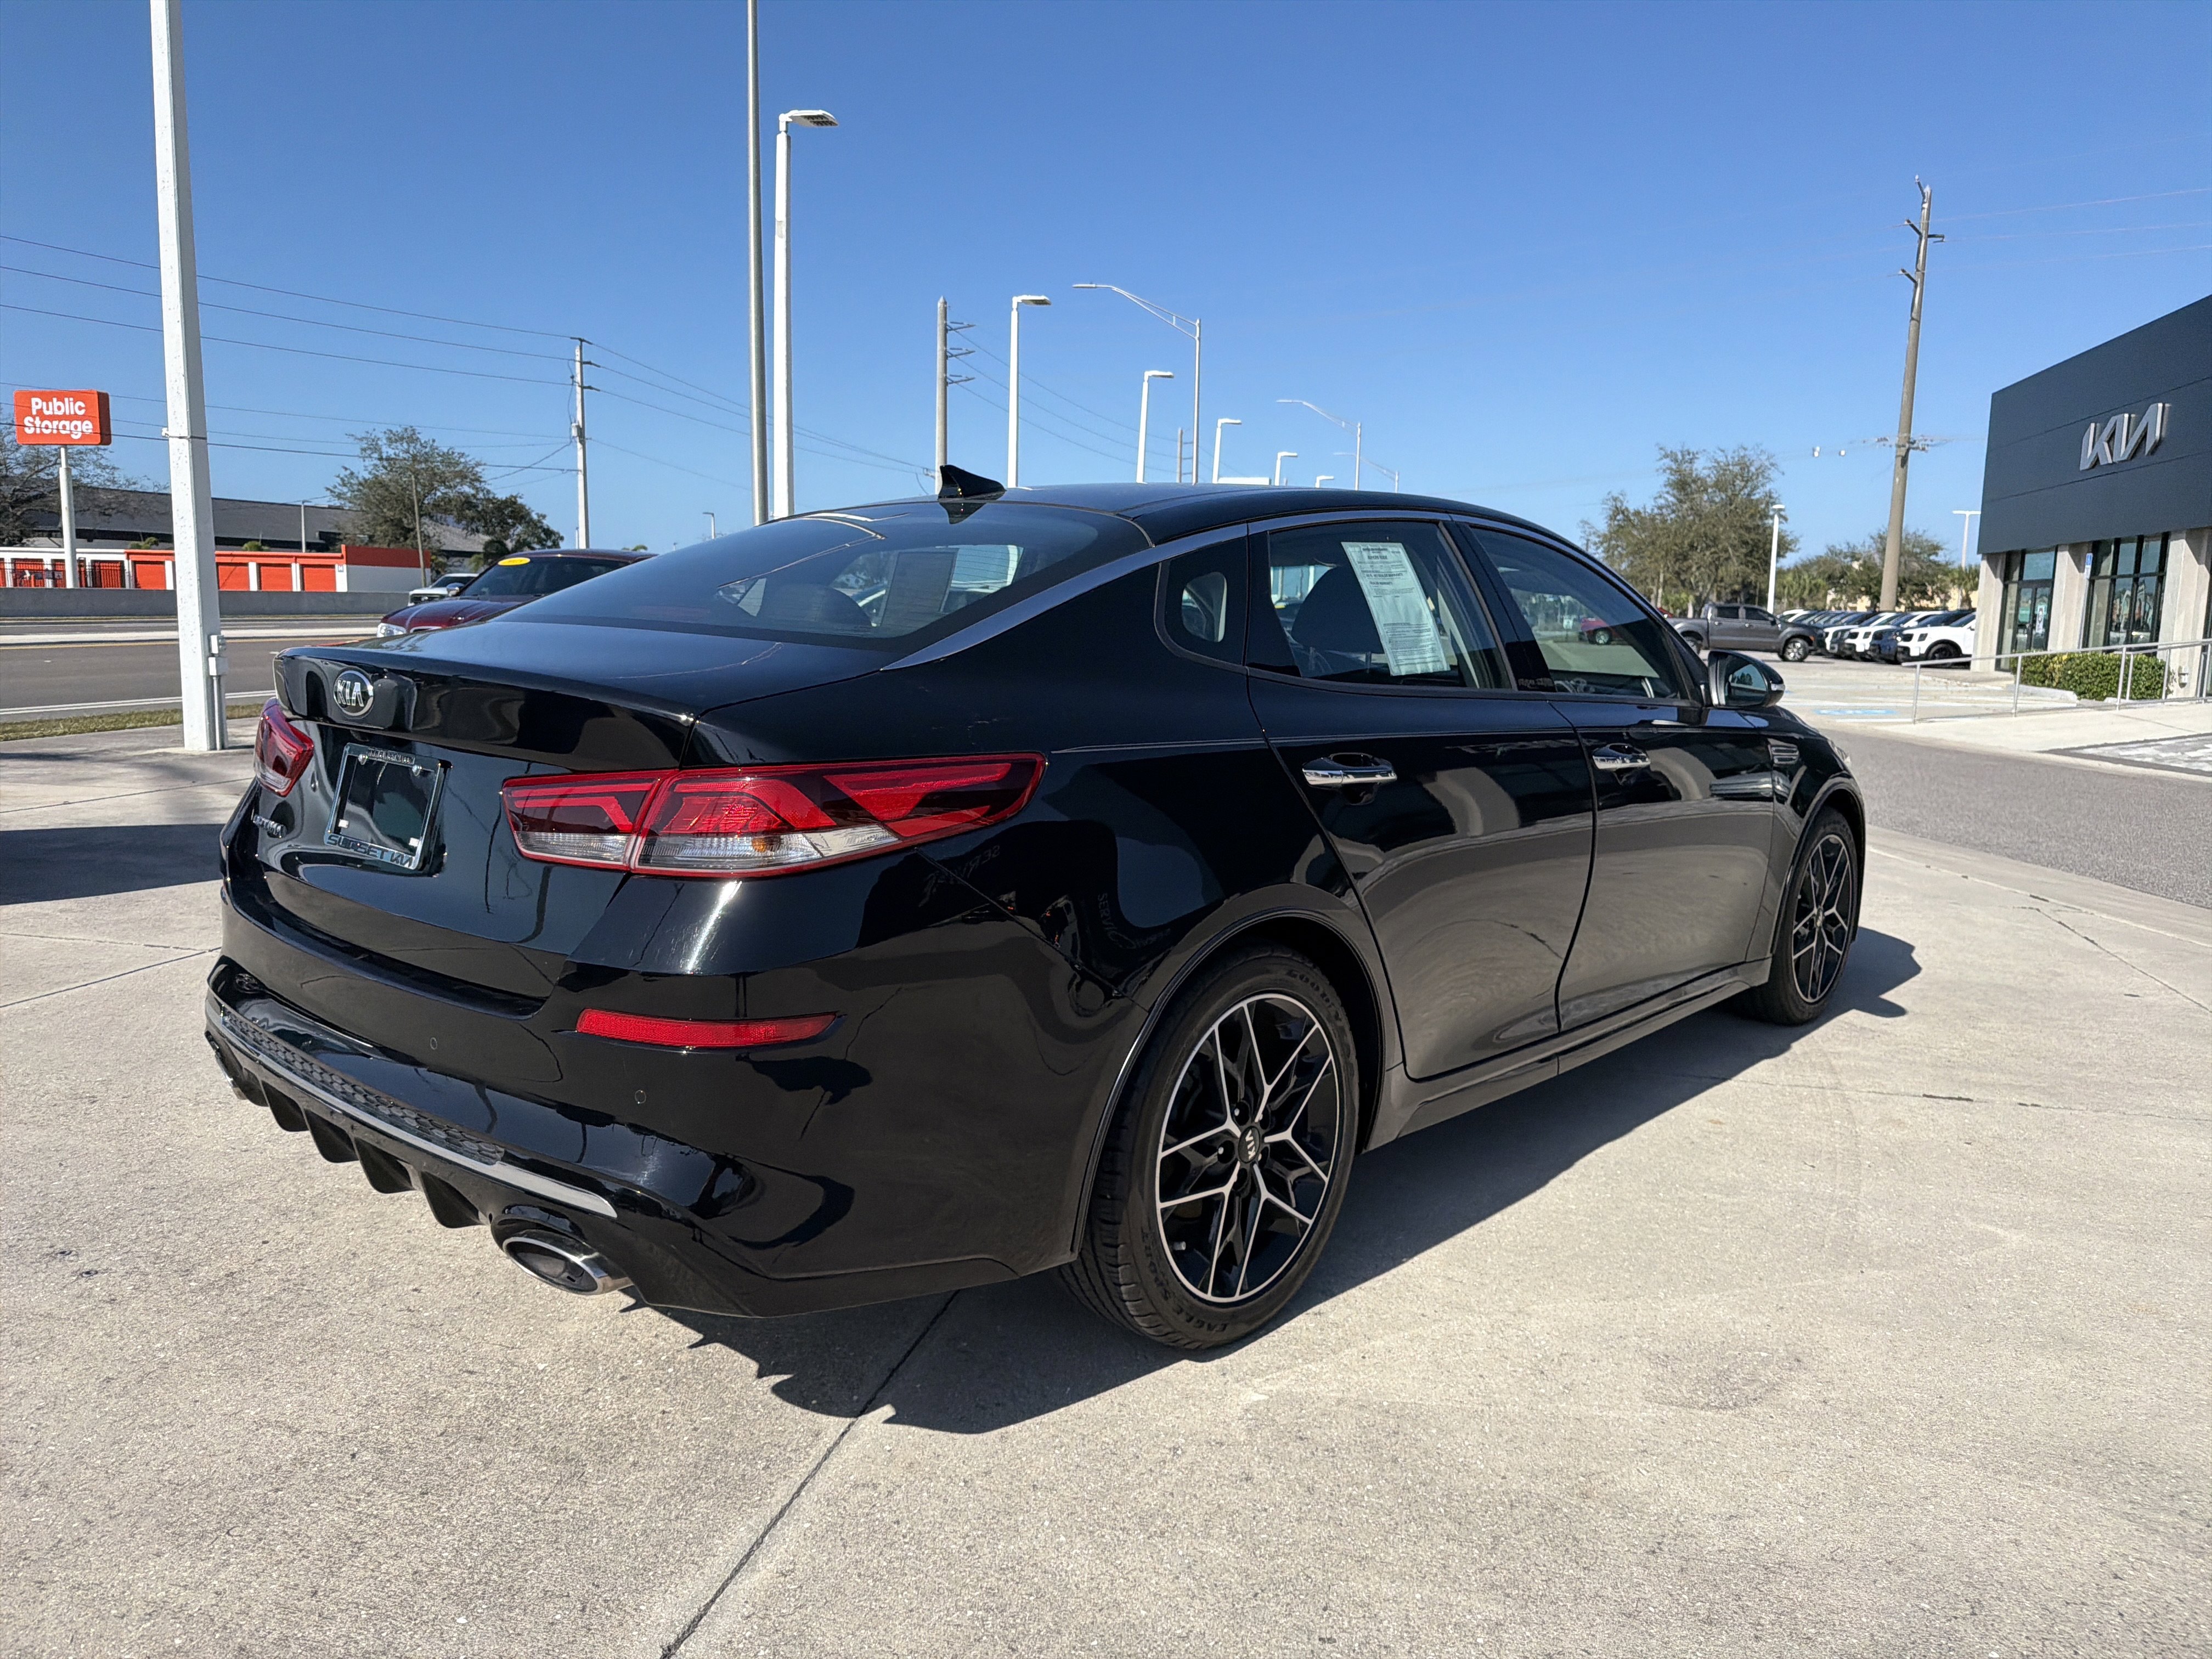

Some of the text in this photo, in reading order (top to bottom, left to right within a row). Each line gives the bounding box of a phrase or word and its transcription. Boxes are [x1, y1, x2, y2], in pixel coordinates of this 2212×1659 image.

[31, 397, 86, 416] Public
[24, 416, 93, 439] Storage
[2079, 402, 2164, 471] KIA
[337, 679, 364, 707] KIA
[326, 834, 389, 860] SUNSET
[1245, 1129, 1256, 1160] KIA
